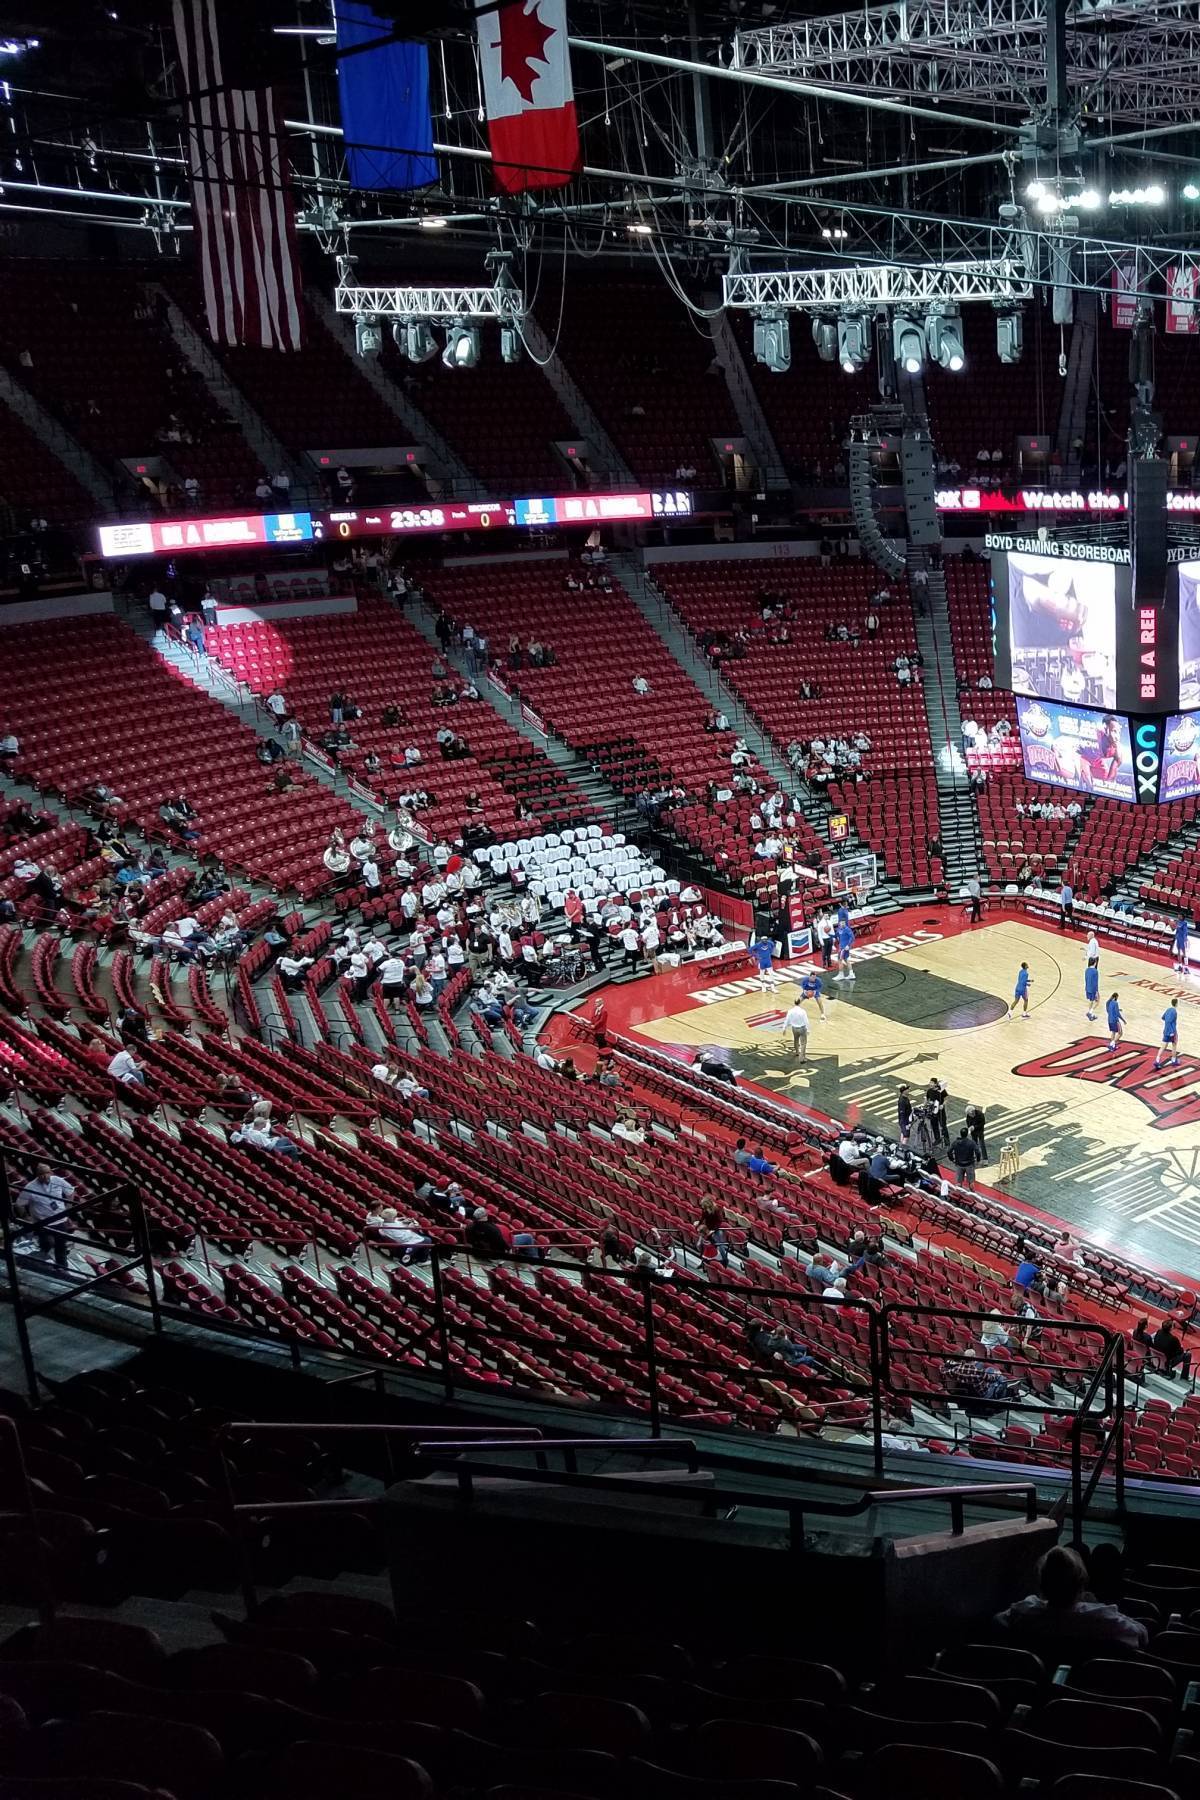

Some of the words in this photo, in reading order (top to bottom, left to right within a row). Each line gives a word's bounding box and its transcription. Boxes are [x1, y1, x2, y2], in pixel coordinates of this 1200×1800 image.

[1022, 491, 1084, 509] Watch
[1088, 491, 1114, 508] the
[391, 509, 445, 528] 23:38
[480, 513, 490, 527] 0
[339, 522, 350, 537] 0
[985, 534, 1013, 550] BOYD
[1016, 538, 1060, 555] GAMING
[1063, 543, 1131, 562] SCOREBOAR
[1141, 650, 1156, 667] A
[1141, 673, 1156, 698] BE
[1136, 724, 1159, 795] COX
